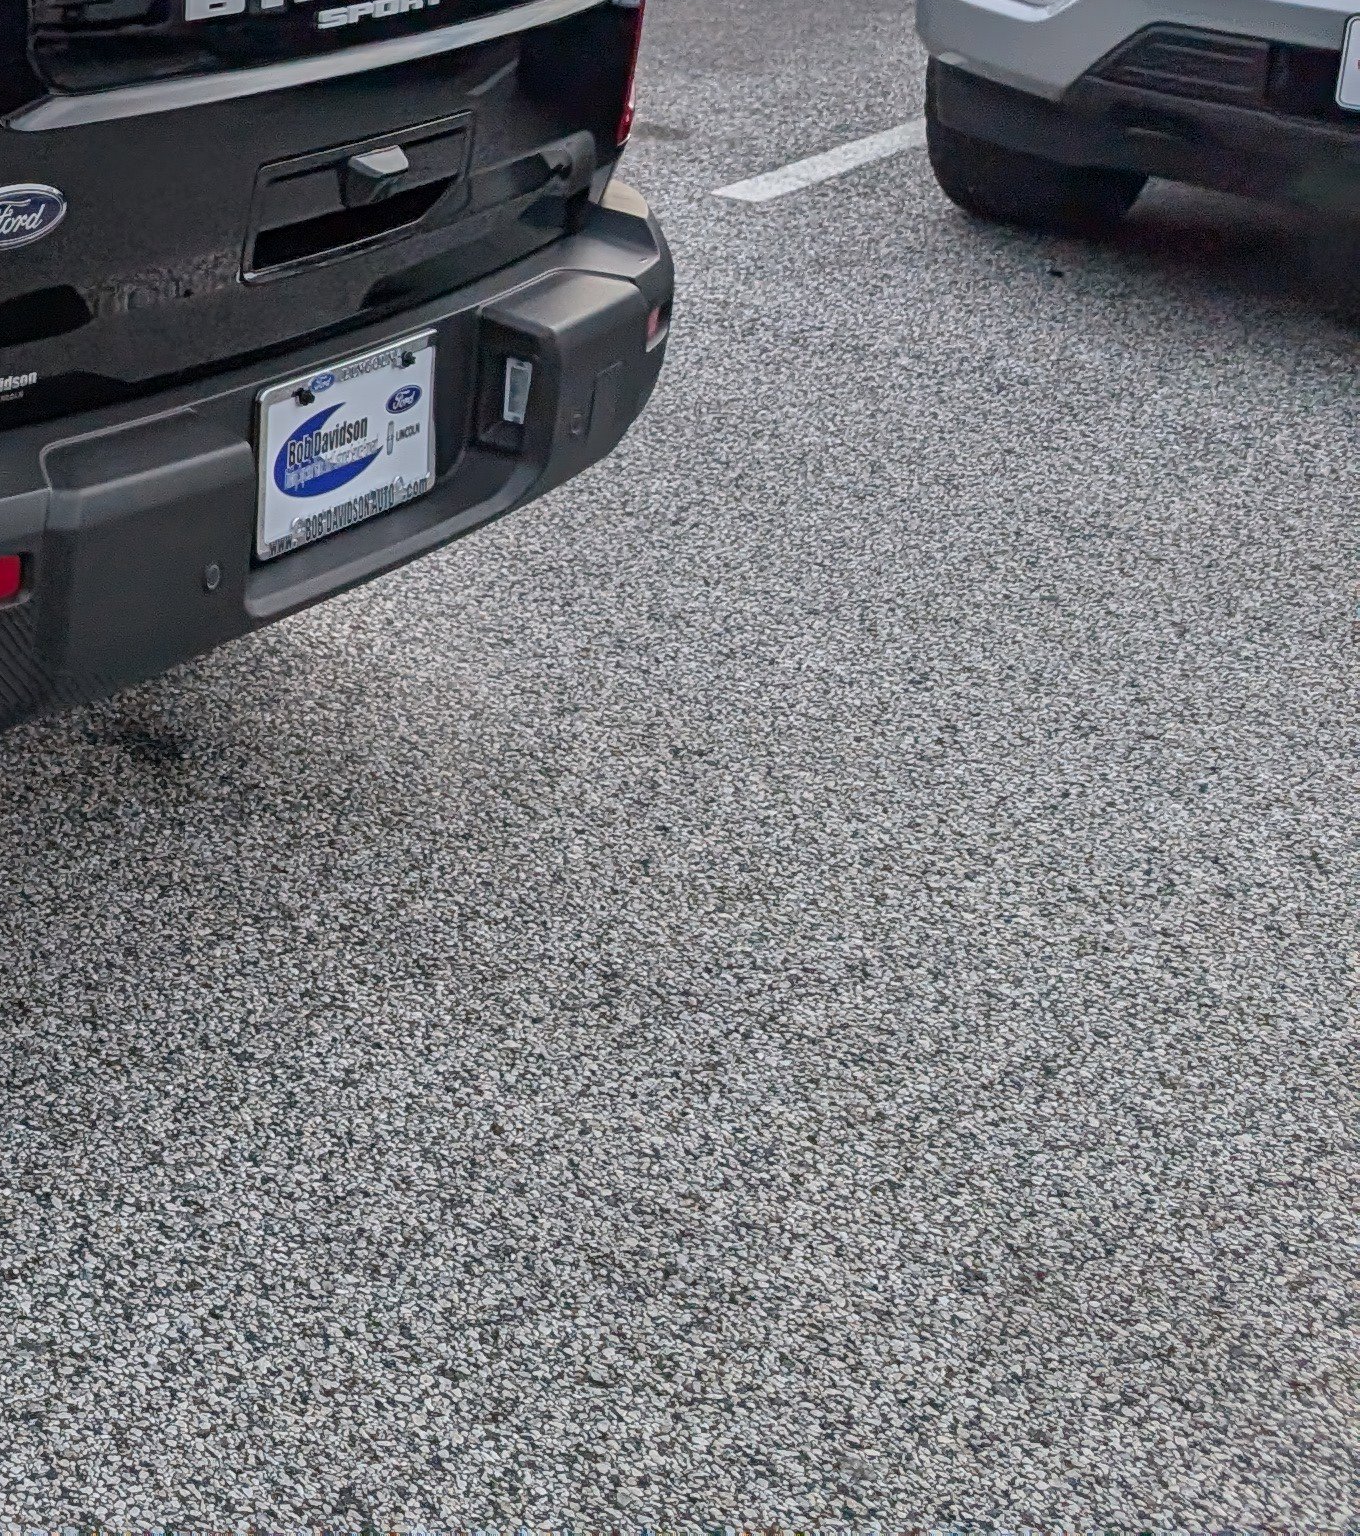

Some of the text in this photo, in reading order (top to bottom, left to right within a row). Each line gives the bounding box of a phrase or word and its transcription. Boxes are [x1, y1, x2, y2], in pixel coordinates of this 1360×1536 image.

[288, 436, 312, 466] Bob
[314, 417, 368, 457] Davidson
[395, 423, 420, 441] LINCOLN
